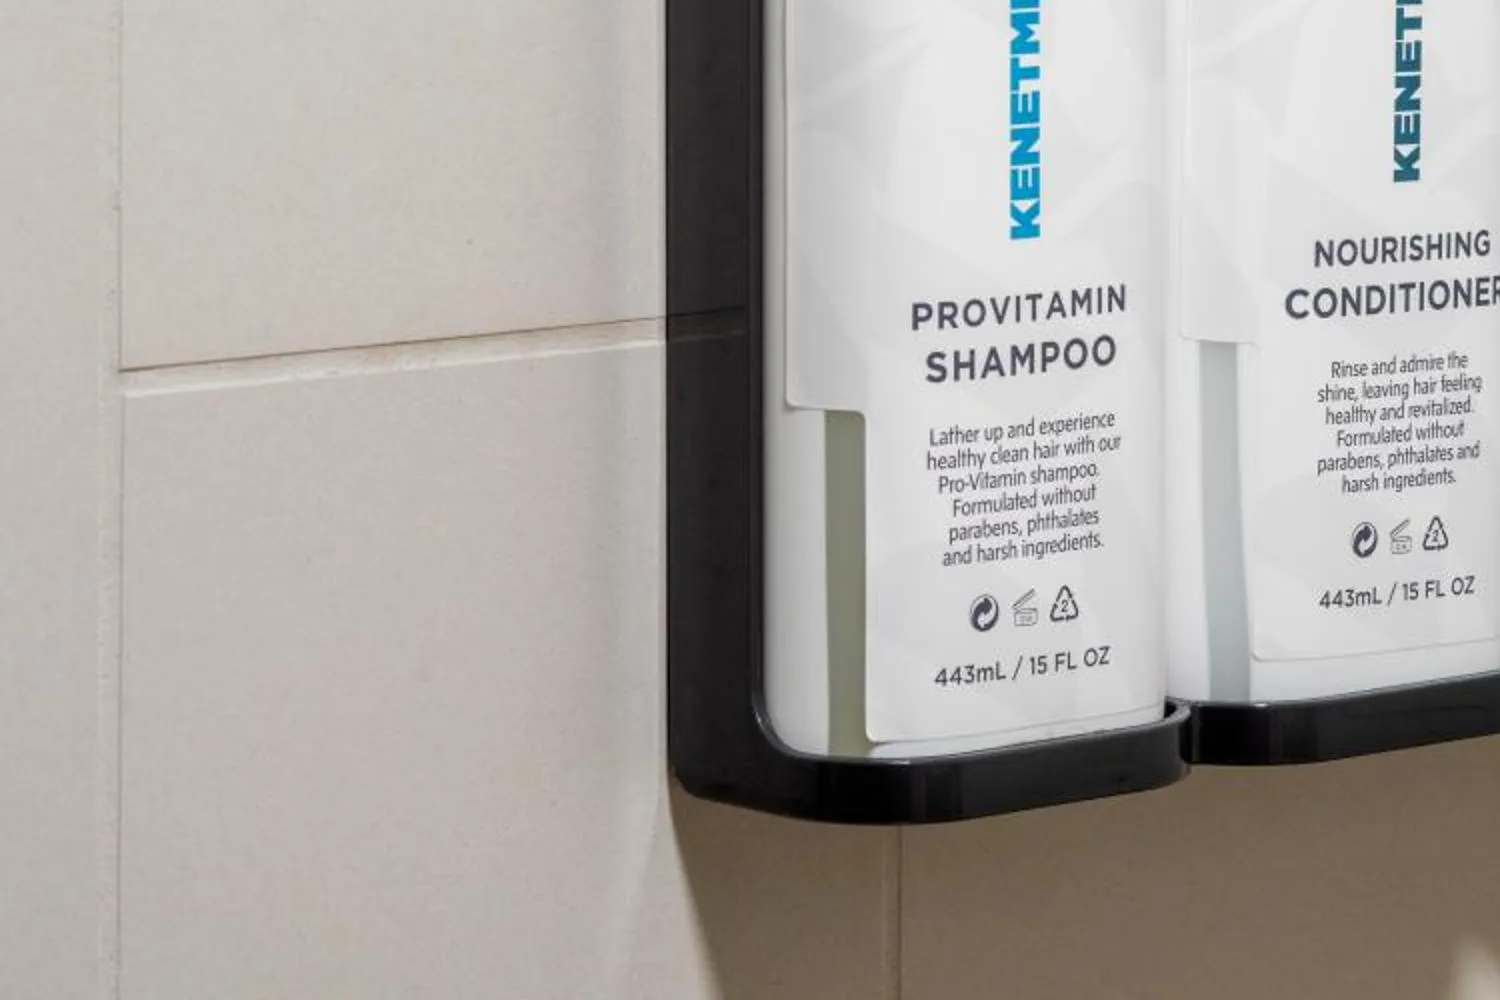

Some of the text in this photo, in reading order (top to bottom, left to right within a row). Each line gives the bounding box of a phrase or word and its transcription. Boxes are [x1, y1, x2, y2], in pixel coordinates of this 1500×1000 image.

[1314, 229, 1490, 268] NOURISHING
[912, 284, 1126, 331] PROVITAMIN
[926, 334, 1116, 383] SHAMPOO
[1331, 351, 1468, 379] Rinse and admire the
[1317, 373, 1483, 404] shine, leaving hair feeling
[929, 412, 1115, 447] Lather up and experience
[1325, 404, 1377, 430] healthy
[1379, 401, 1405, 421] and
[1336, 420, 1465, 448] Formulated without
[927, 435, 1121, 470] healthy clean hair with our
[1317, 440, 1480, 477] parabens, phthalates and
[938, 467, 1027, 494] Pro-Vitamin
[1342, 467, 1456, 493] harsh ingredients.
[951, 483, 1097, 518] Formulated without
[949, 508, 1101, 546] parabens, phthalates
[942, 531, 1104, 566] and harsh ingredients.
[1319, 575, 1475, 609] 443mL / 15 FL OZ
[934, 646, 1111, 686] 443mL / 15 FL OZ
